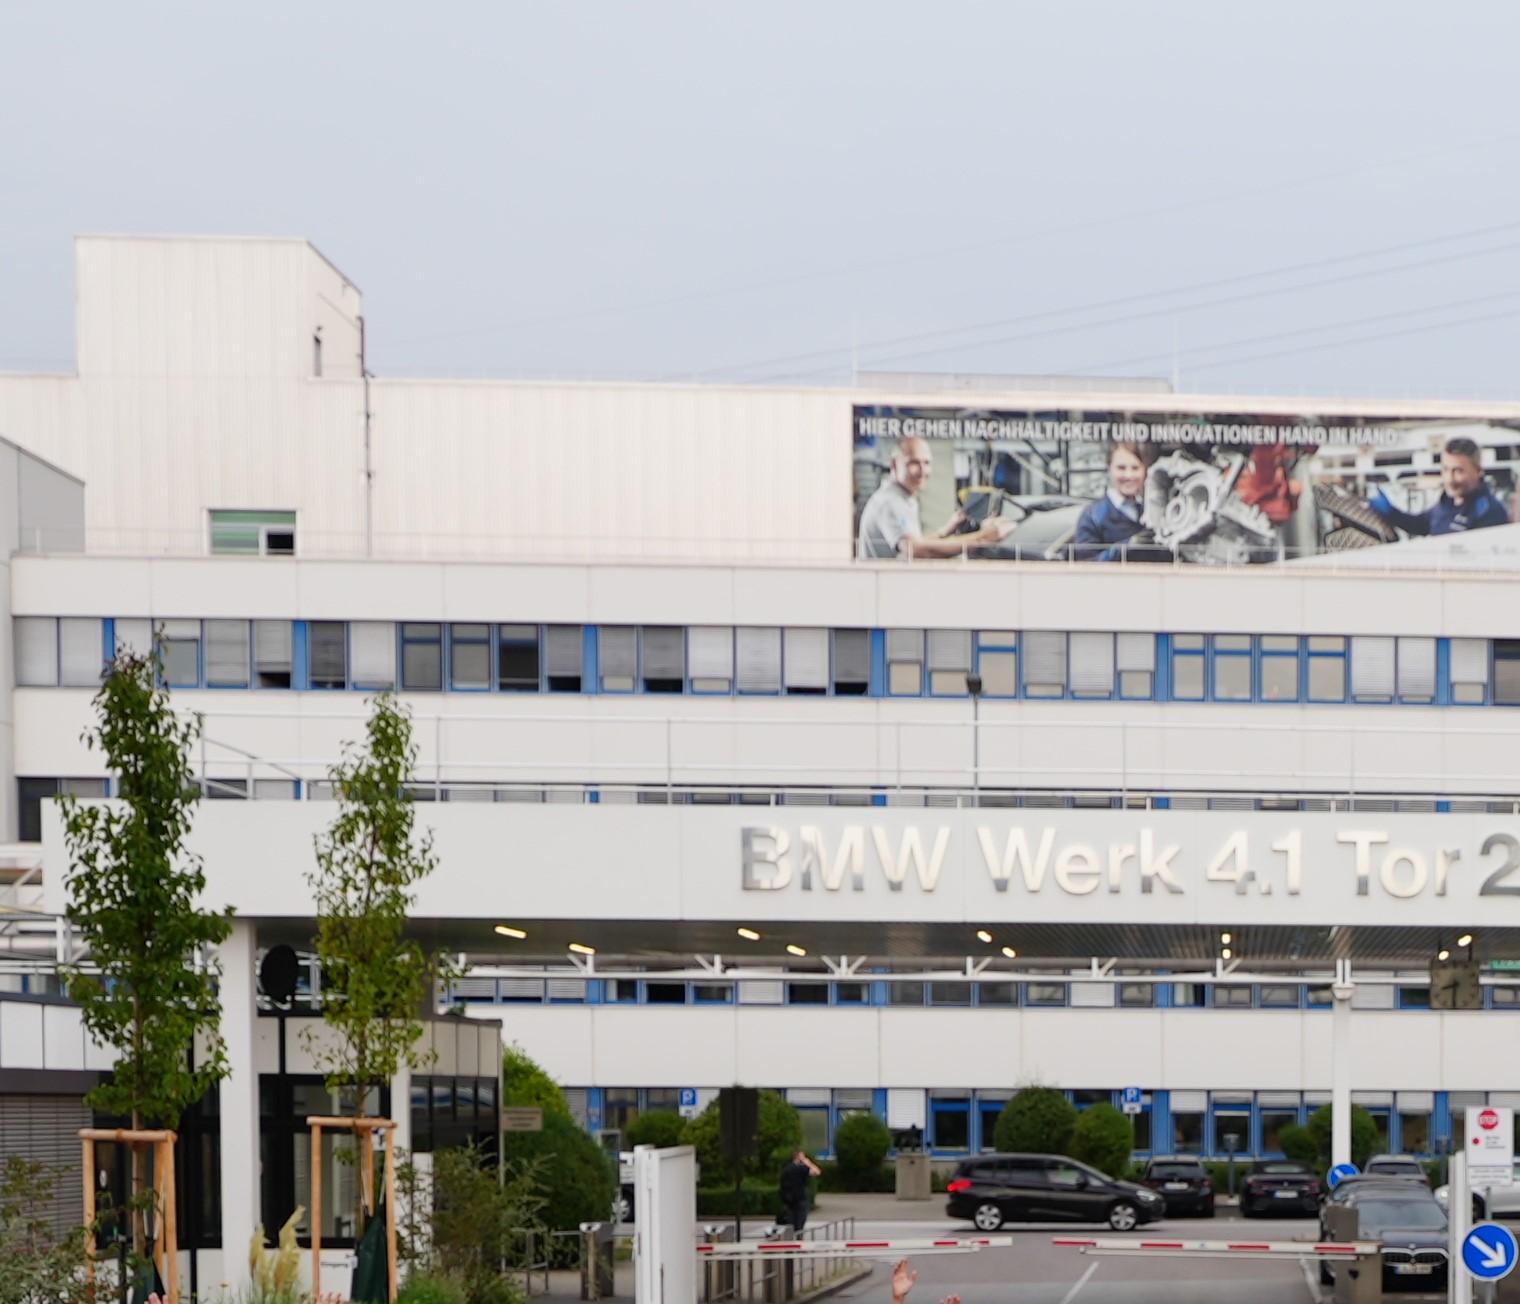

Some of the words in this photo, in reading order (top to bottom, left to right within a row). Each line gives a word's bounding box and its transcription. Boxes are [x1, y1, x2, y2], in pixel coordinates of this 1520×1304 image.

[858, 416, 901, 438] HIER
[902, 417, 962, 439] GEHEN
[963, 418, 1110, 441] NACHHALTIGKEIT
[1111, 421, 1150, 443] UND
[1150, 422, 1277, 445] INNOVATIONEN
[1278, 424, 1328, 446] HAND
[1328, 426, 1349, 446] IN
[1349, 426, 1398, 446] HAND
[741, 826, 951, 892] BMW
[976, 826, 1184, 896] Werk
[1207, 829, 1302, 896] 4.1
[1336, 831, 1460, 899] Tor
